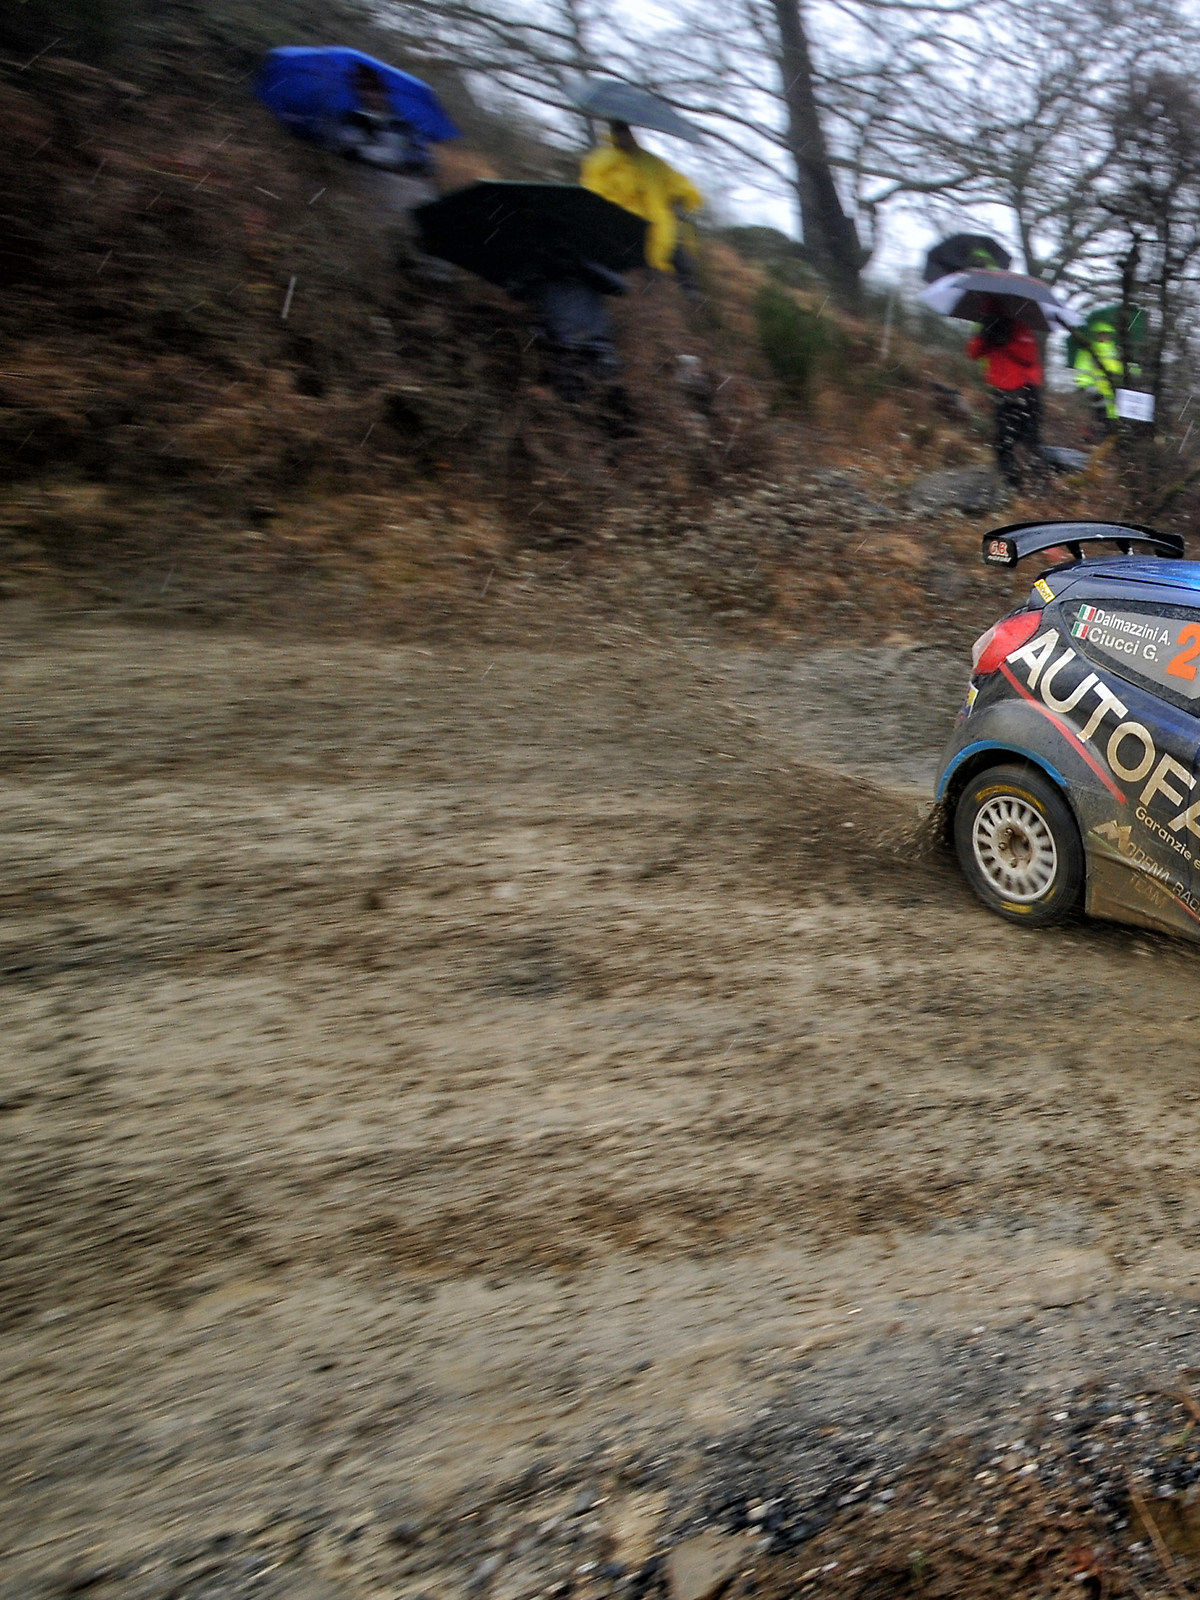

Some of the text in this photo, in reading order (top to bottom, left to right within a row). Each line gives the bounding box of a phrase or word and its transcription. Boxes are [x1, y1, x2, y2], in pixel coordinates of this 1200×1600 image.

[1088, 627, 1159, 662] Ciucci G.
[1094, 609, 1171, 646] Dalmazzini A.
[1135, 806, 1192, 861] Garanzie
